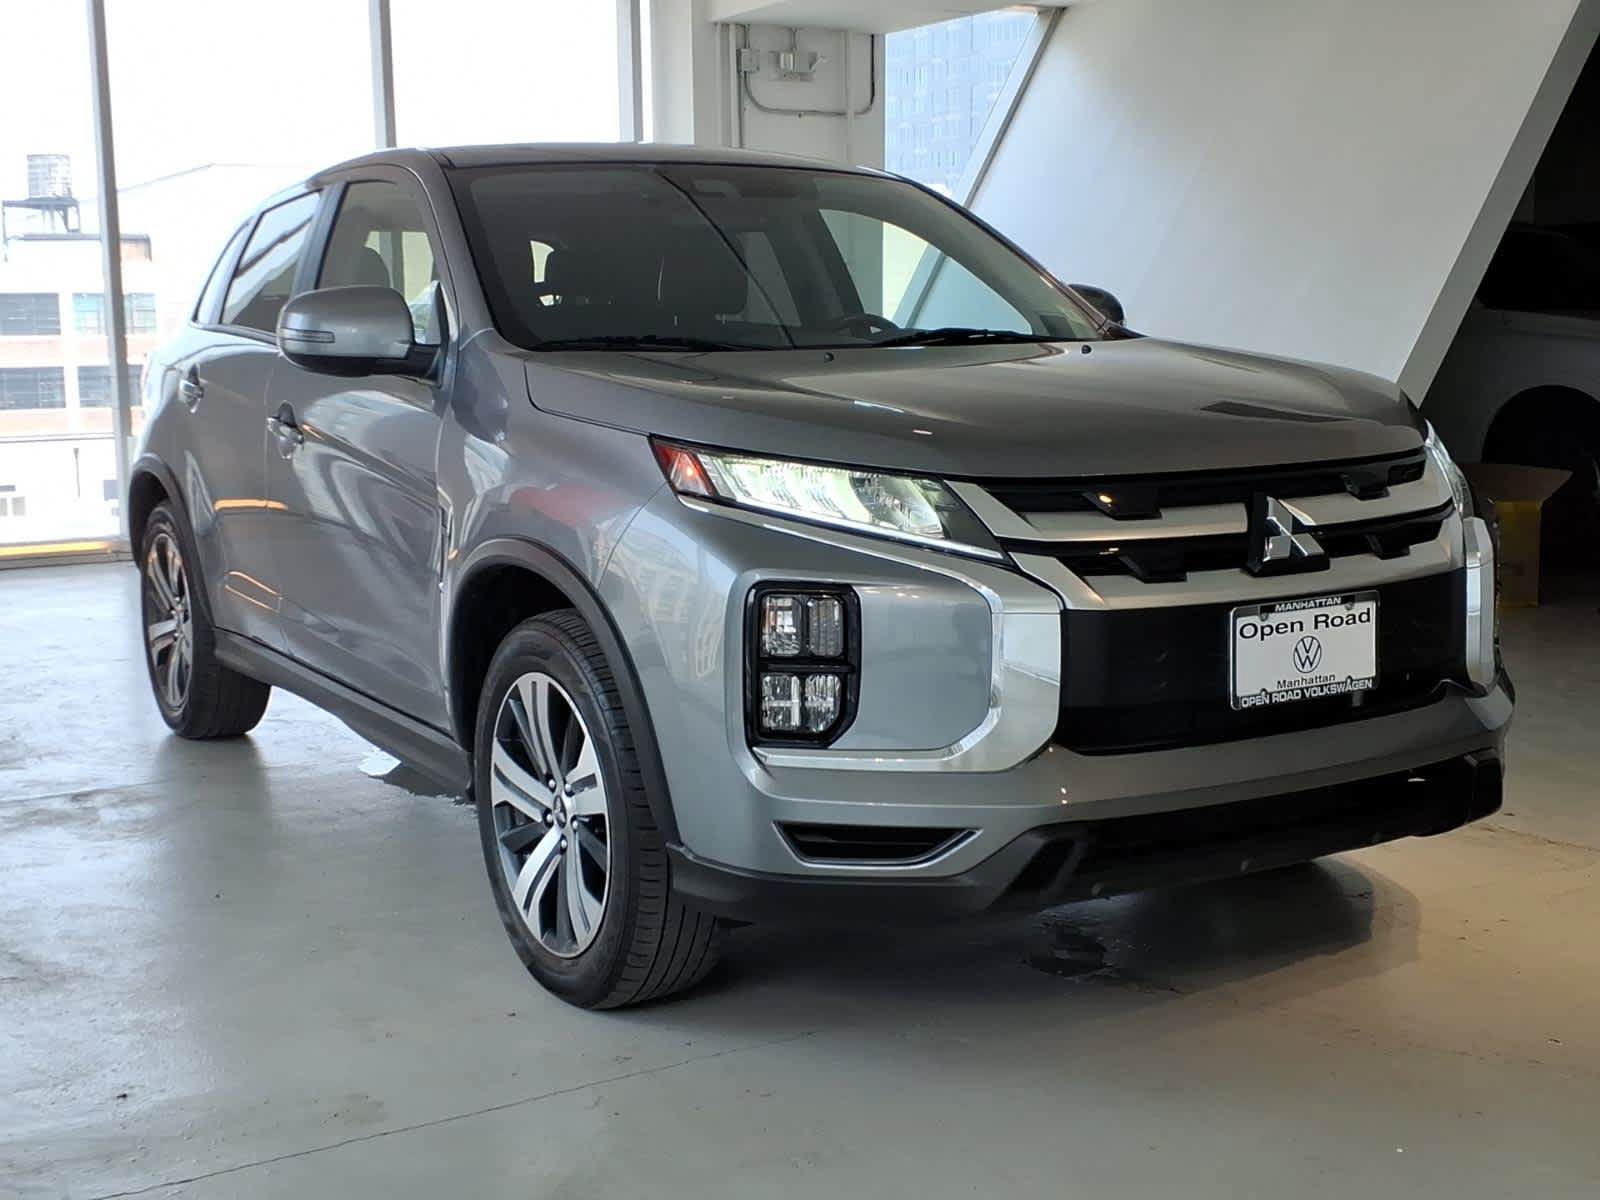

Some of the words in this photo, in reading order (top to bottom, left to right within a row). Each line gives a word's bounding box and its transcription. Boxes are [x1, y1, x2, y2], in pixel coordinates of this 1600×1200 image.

[1274, 597, 1341, 612] MANHATTAN
[1239, 620, 1304, 641] Open
[1313, 608, 1371, 630] Road
[1276, 674, 1336, 689] Manhattan
[1241, 693, 1270, 708] OPEN
[1272, 690, 1302, 703] ROAD
[1304, 679, 1373, 698] VOLKSWAGEN
